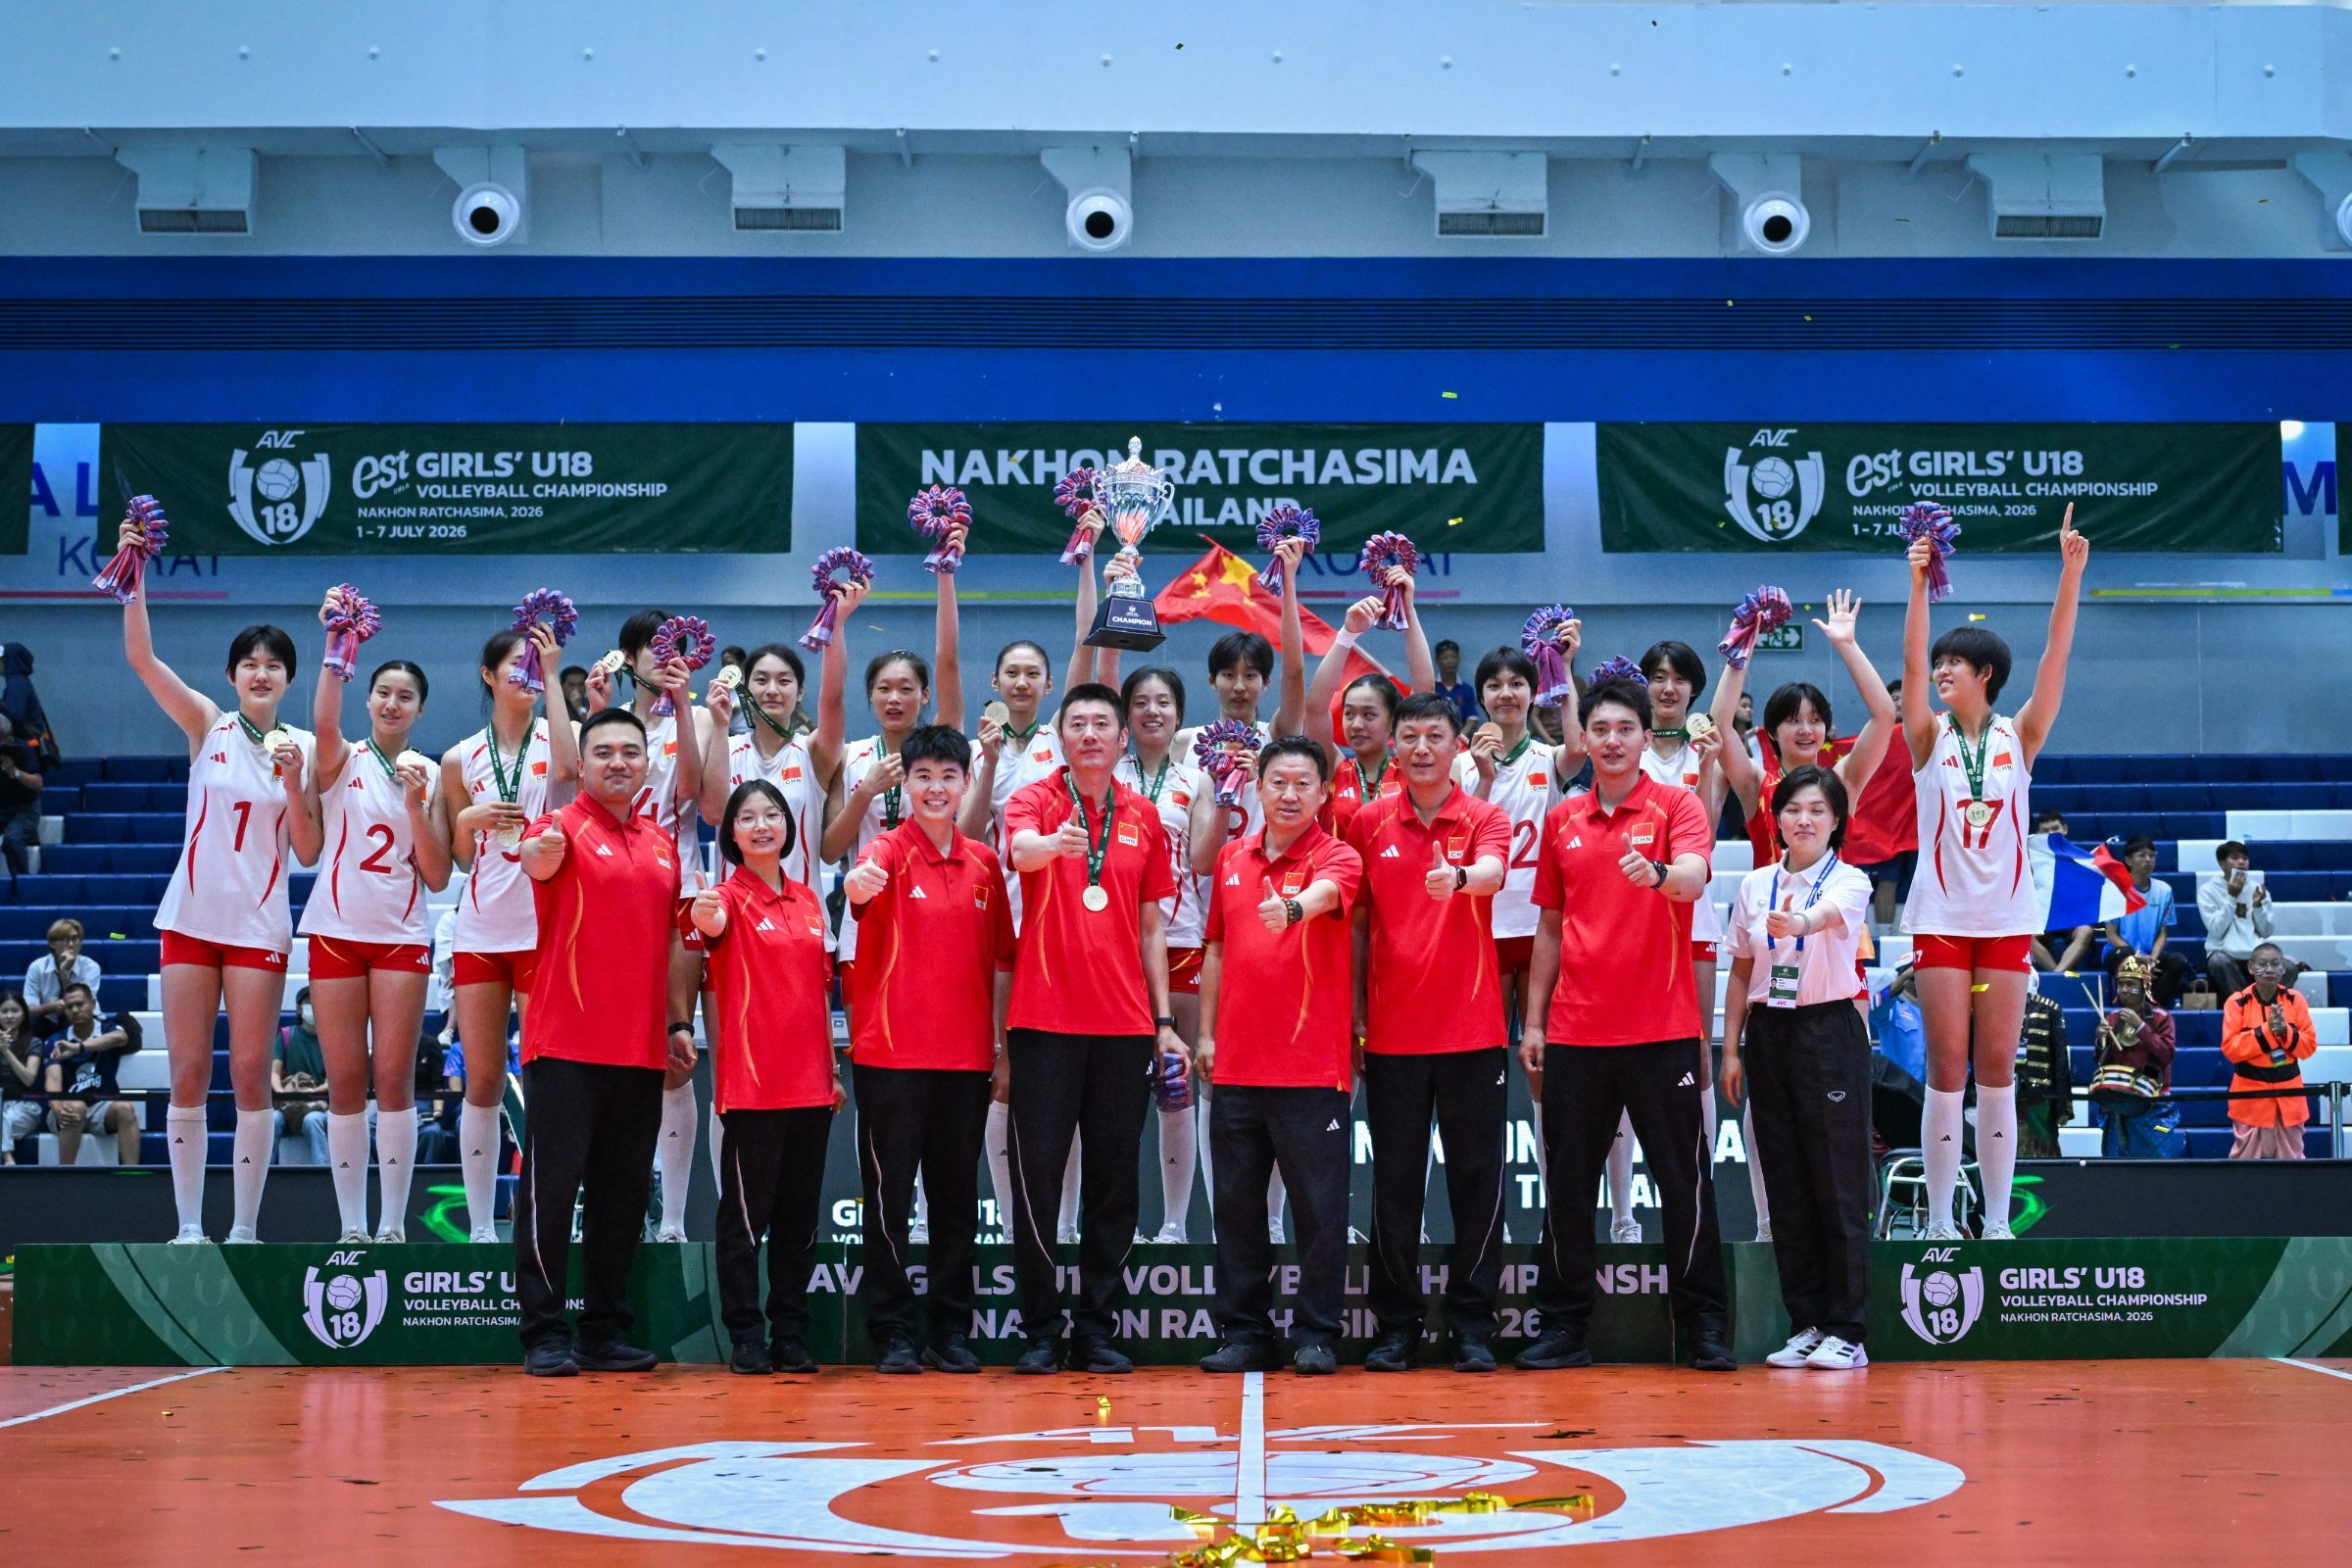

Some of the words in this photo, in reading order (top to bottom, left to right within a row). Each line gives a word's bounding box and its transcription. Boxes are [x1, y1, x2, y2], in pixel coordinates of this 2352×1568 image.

[256, 430, 305, 448] AVC
[1749, 429, 1797, 446] AVC
[353, 450, 409, 498] est
[416, 452, 522, 477] GIRLS'
[532, 452, 592, 476] U18
[1154, 449, 1477, 484] RATCHASIMA
[1846, 449, 1902, 497] est
[1909, 451, 2014, 476] GIRLS'
[2024, 451, 2083, 475] U18
[416, 484, 529, 498] VOLLEYBALL
[533, 483, 666, 497] CHAMPIONSHIP
[1910, 483, 2022, 496] VOLLEYBALL
[2026, 483, 2158, 496] CHAMPIONSHIP
[261, 503, 299, 534] 18
[359, 508, 416, 517] NAKHON
[419, 507, 507, 519] RATCHASIMA,
[511, 507, 543, 516] 2026
[1156, 498, 1300, 525] AILAN
[1757, 501, 1794, 531] 18
[2005, 505, 2036, 515] 2026
[357, 526, 363, 537] 1
[377, 525, 385, 537] 7
[389, 526, 424, 537] JULY
[429, 525, 466, 537] 2026
[1853, 524, 1858, 535] 1
[1873, 523, 1882, 535] 7
[1112, 616, 1152, 626] CHAMPION
[233, 801, 252, 853] 1
[1956, 799, 2004, 849] 17
[360, 824, 394, 874] 2
[1511, 819, 1538, 869] 2
[325, 1250, 367, 1265] AVC
[1921, 1248, 1961, 1262] AVC
[405, 1272, 493, 1293] GIRLS'
[806, 1263, 863, 1295] AV
[905, 1265, 1015, 1295] GLS
[2000, 1267, 2087, 1289] GIRLS'
[2095, 1267, 2144, 1289] U18
[404, 1299, 497, 1310] VOLLEYBALL
[2001, 1296, 2093, 1306] VOLLEYBALL
[2097, 1295, 2207, 1305] CHAMPIONSHIP
[329, 1311, 362, 1340] 18
[1928, 1308, 1959, 1336] 18
[2052, 1312, 2124, 1323] RATCHASIMA,
[2127, 1312, 2153, 1321] 2026
